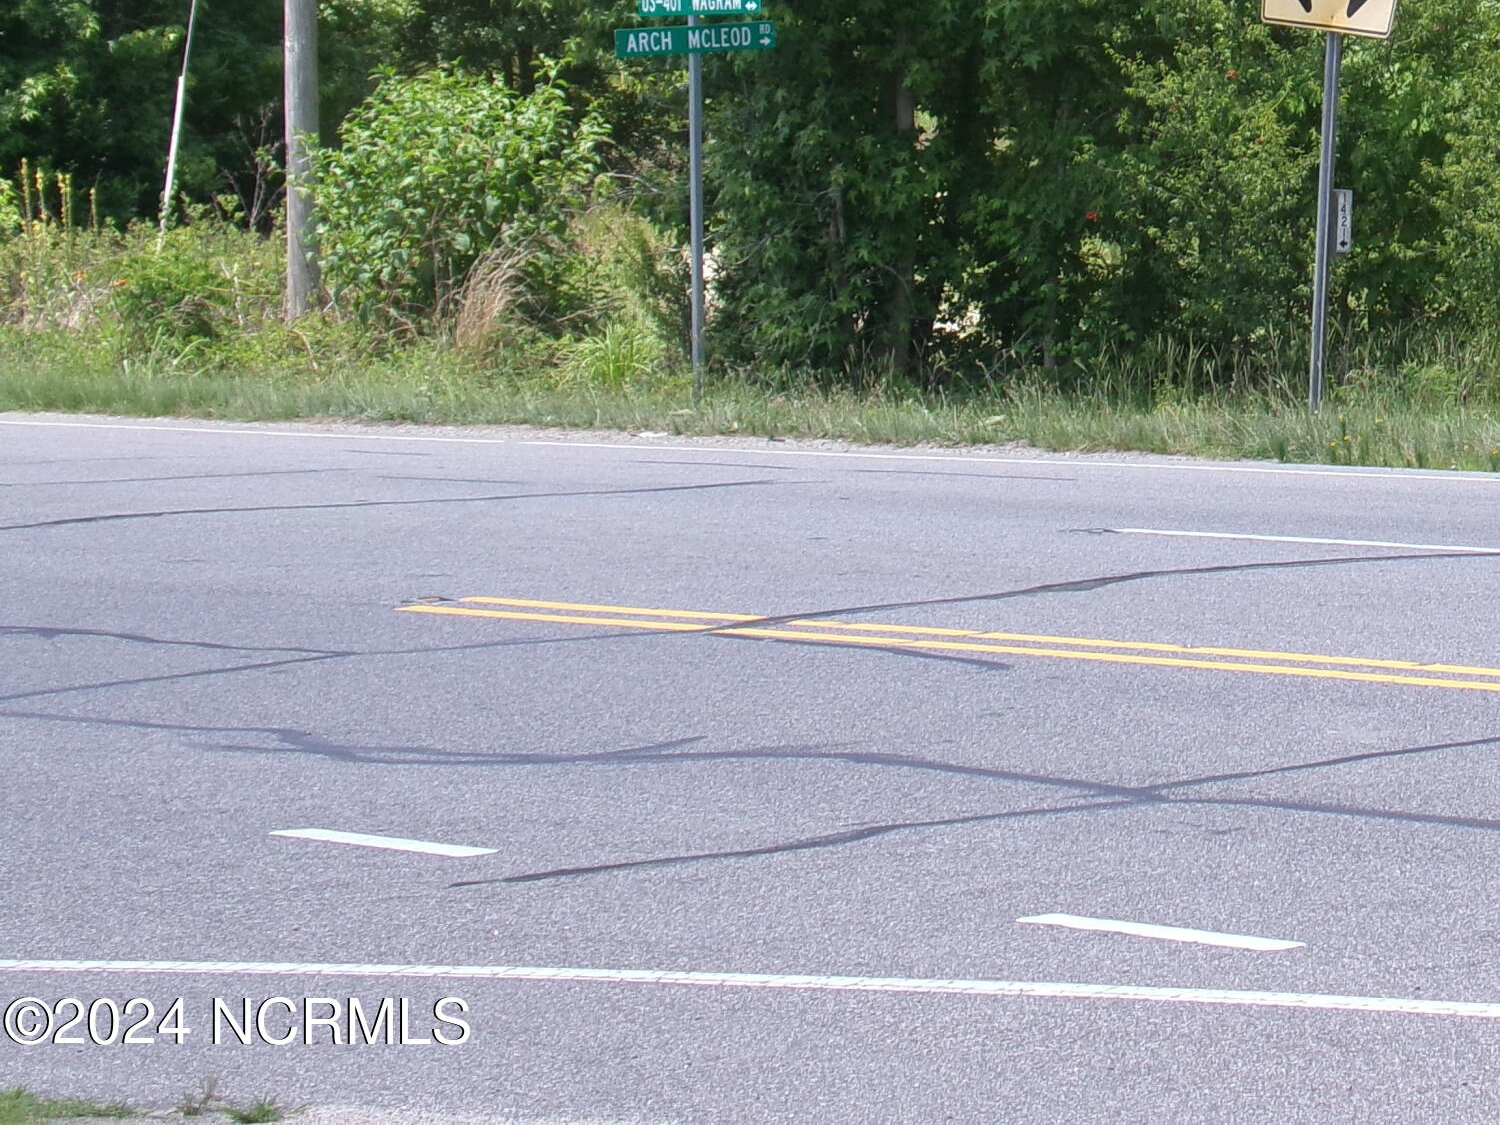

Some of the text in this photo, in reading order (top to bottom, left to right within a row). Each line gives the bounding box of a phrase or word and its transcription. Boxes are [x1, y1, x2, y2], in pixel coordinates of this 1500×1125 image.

[626, 23, 771, 53] ARCH MCLEOD RD
